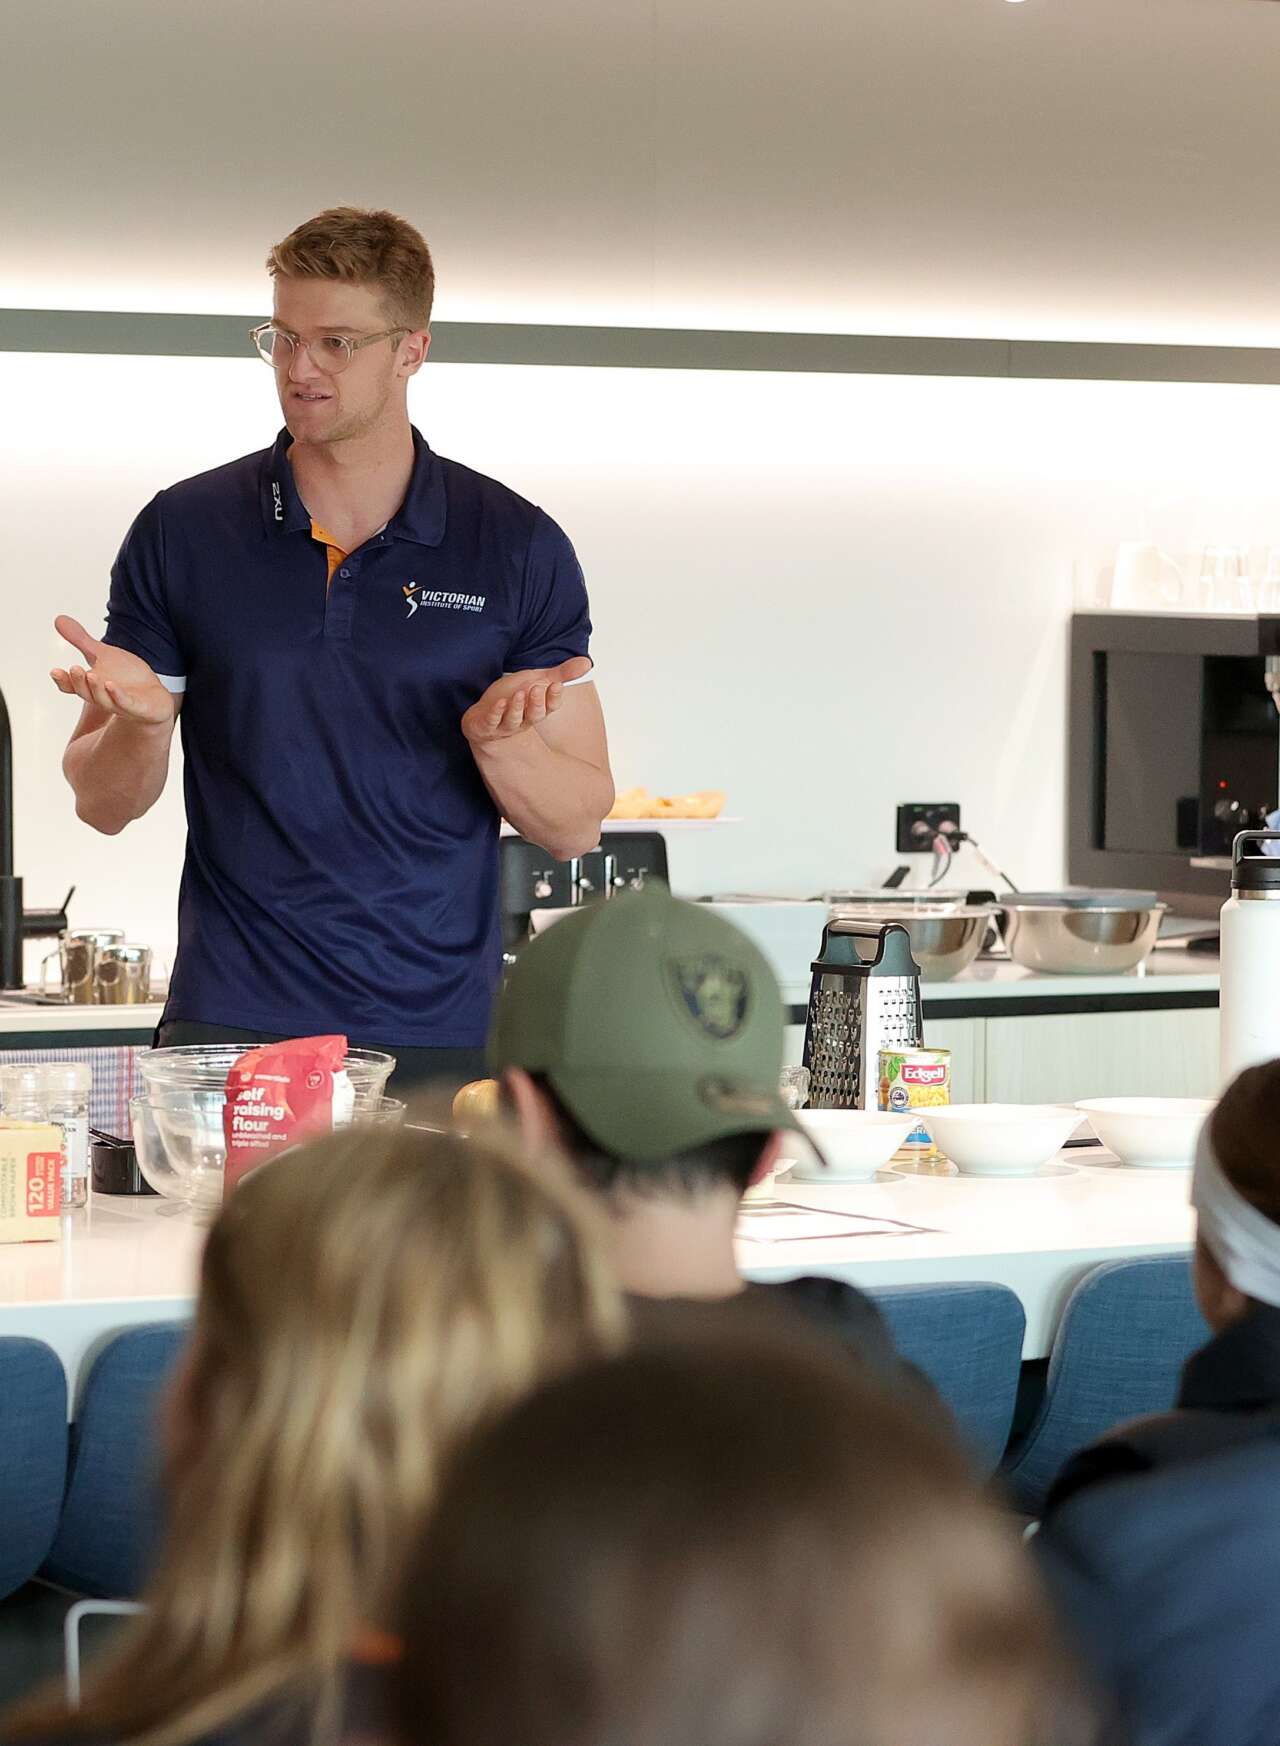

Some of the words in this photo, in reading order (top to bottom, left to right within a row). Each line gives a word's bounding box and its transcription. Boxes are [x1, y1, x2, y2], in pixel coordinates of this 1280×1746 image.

[272, 481, 283, 520] 2XU
[420, 600, 452, 609] INSTITUTE
[463, 604, 483, 613] SPORT
[421, 590, 486, 607] VICTORIAN
[904, 1066, 945, 1083] Edgell
[233, 1102, 285, 1121] raising
[232, 1116, 269, 1132] flour
[28, 1177, 45, 1214] 120
